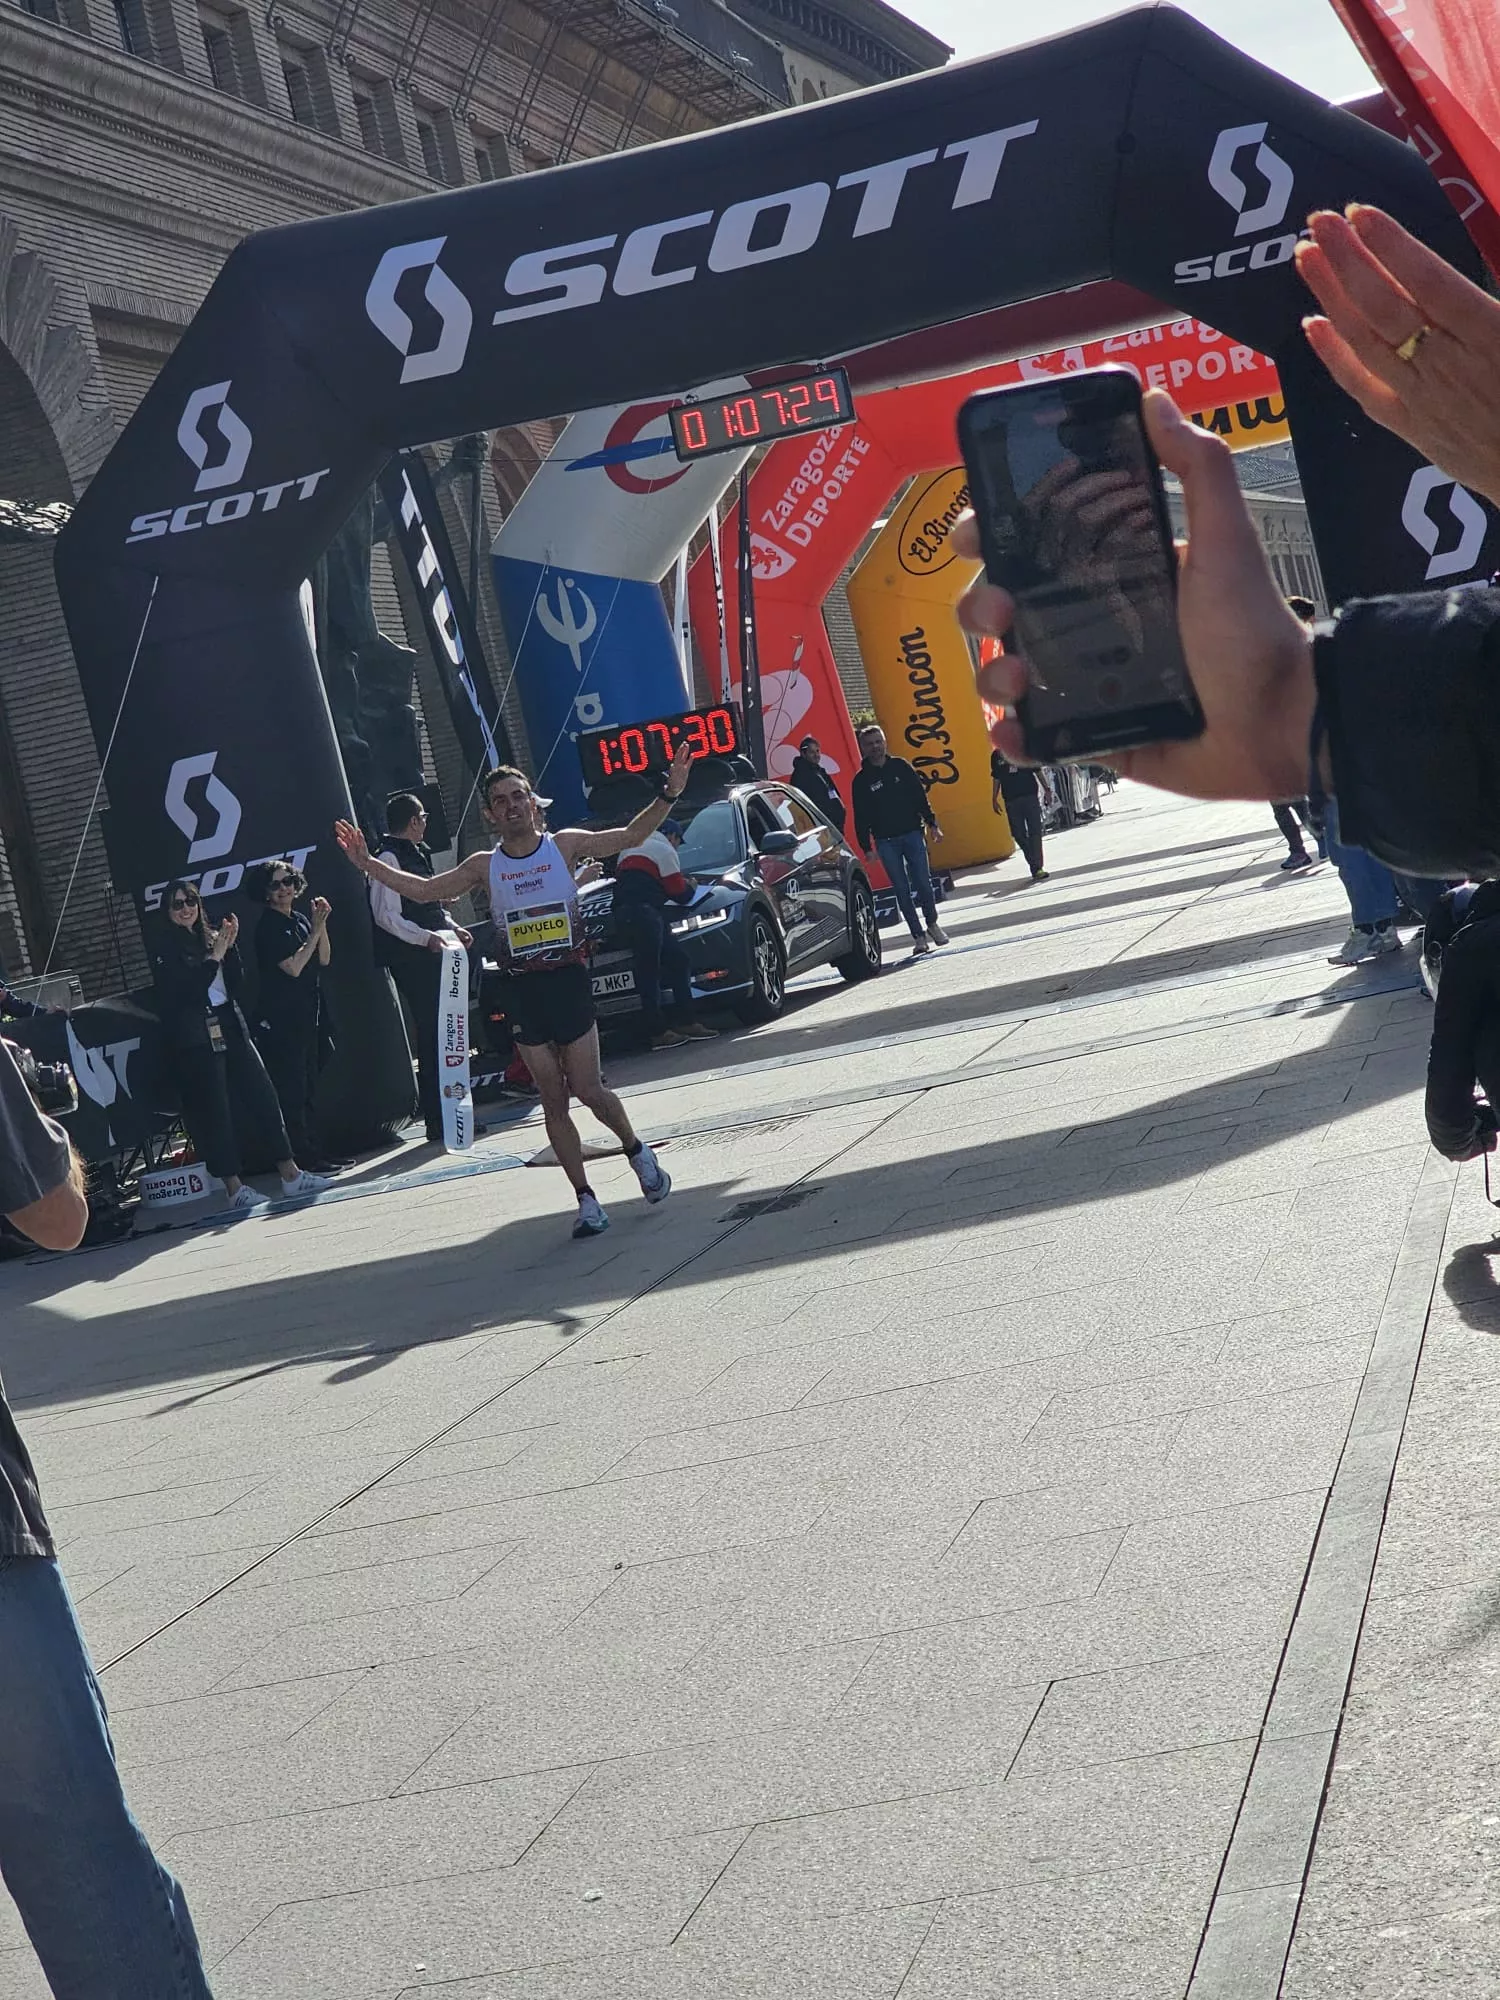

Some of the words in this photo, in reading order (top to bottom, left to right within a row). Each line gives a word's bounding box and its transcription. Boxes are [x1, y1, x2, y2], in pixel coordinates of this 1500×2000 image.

[493, 119, 1040, 325] SCOTT
[1174, 229, 1311, 284] SCO
[1103, 317, 1223, 353] Zarag
[760, 425, 844, 532] Zaragoza
[785, 434, 871, 548] DEPORTE
[125, 468, 331, 544] SCOTT
[897, 626, 952, 749] Rincón
[912, 749, 960, 793] El
[514, 919, 564, 937] PUYUELO
[604, 974, 630, 991] MKP
[445, 1013, 456, 1052] Zaragoza
[456, 1014, 465, 1052] DEPORTE
[454, 1107, 464, 1146] SCOTT
